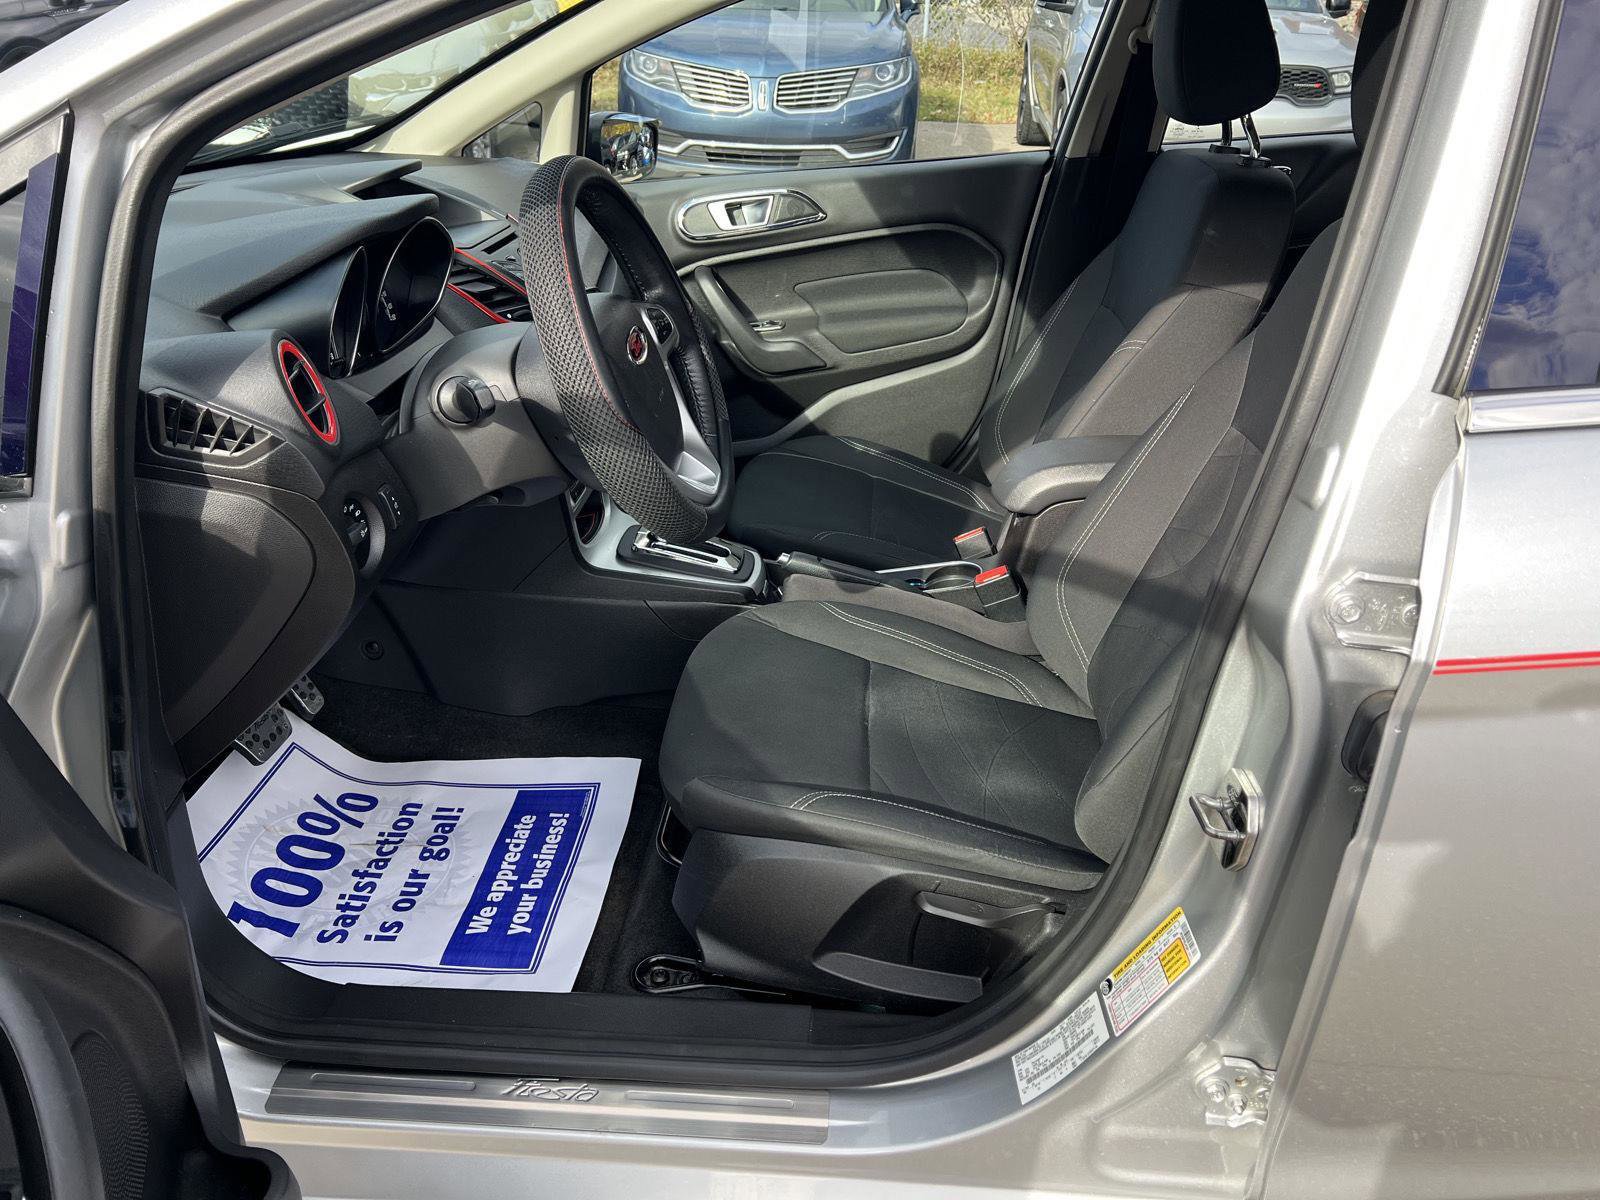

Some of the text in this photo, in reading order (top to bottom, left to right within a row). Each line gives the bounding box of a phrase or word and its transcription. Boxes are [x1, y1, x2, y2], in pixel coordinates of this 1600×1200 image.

[227, 792, 379, 938] 100%
[316, 802, 423, 944] Satisfaction
[364, 806, 465, 942] is our goal!
[465, 815, 536, 935] We appreciate
[507, 813, 570, 936] your business!
